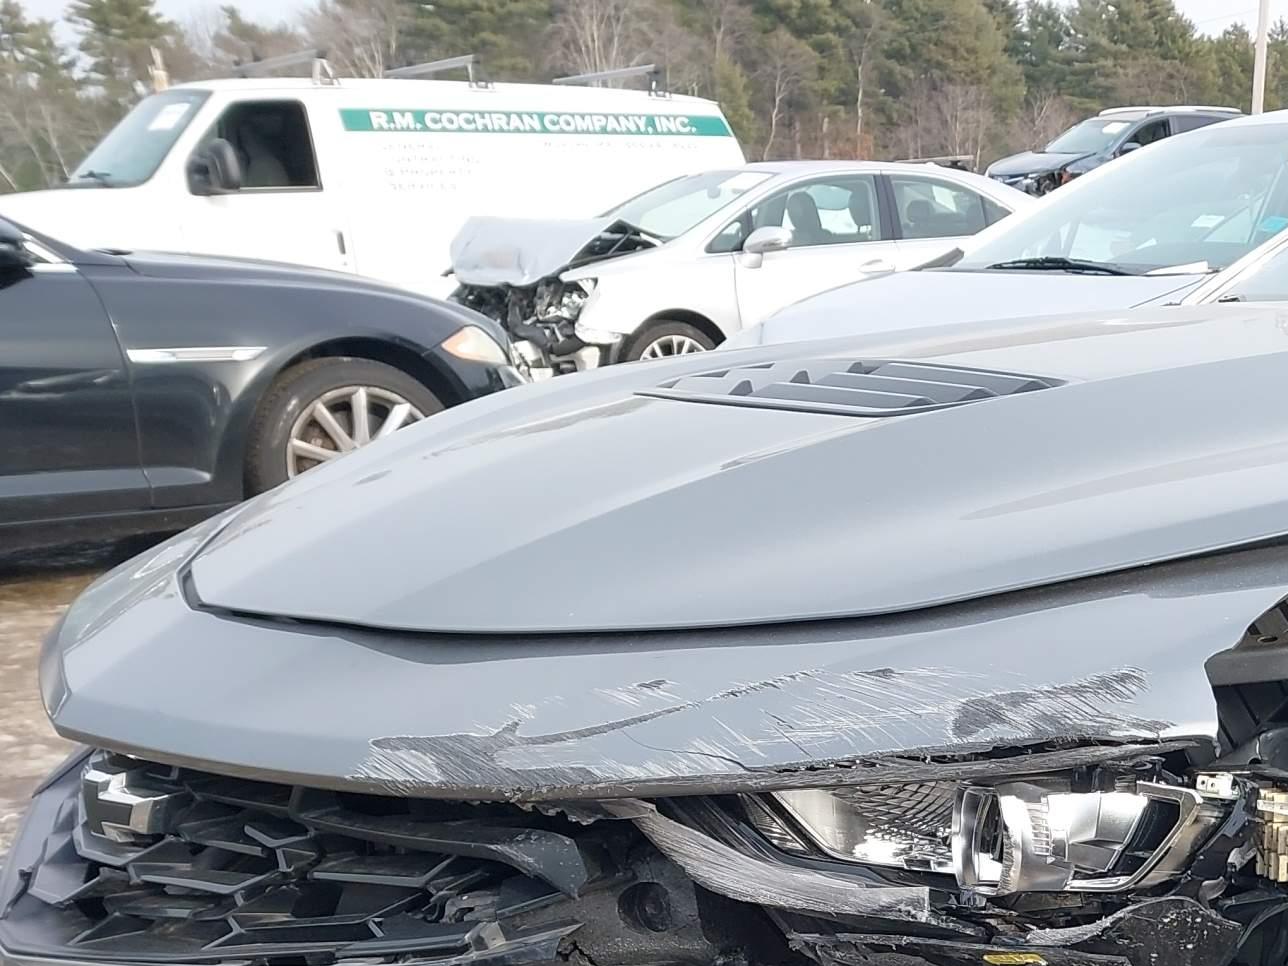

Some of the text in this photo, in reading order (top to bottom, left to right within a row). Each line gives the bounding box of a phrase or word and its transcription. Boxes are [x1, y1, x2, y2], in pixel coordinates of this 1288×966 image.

[368, 111, 698, 134] R.M. COCHRAN COMPANY, INC.
